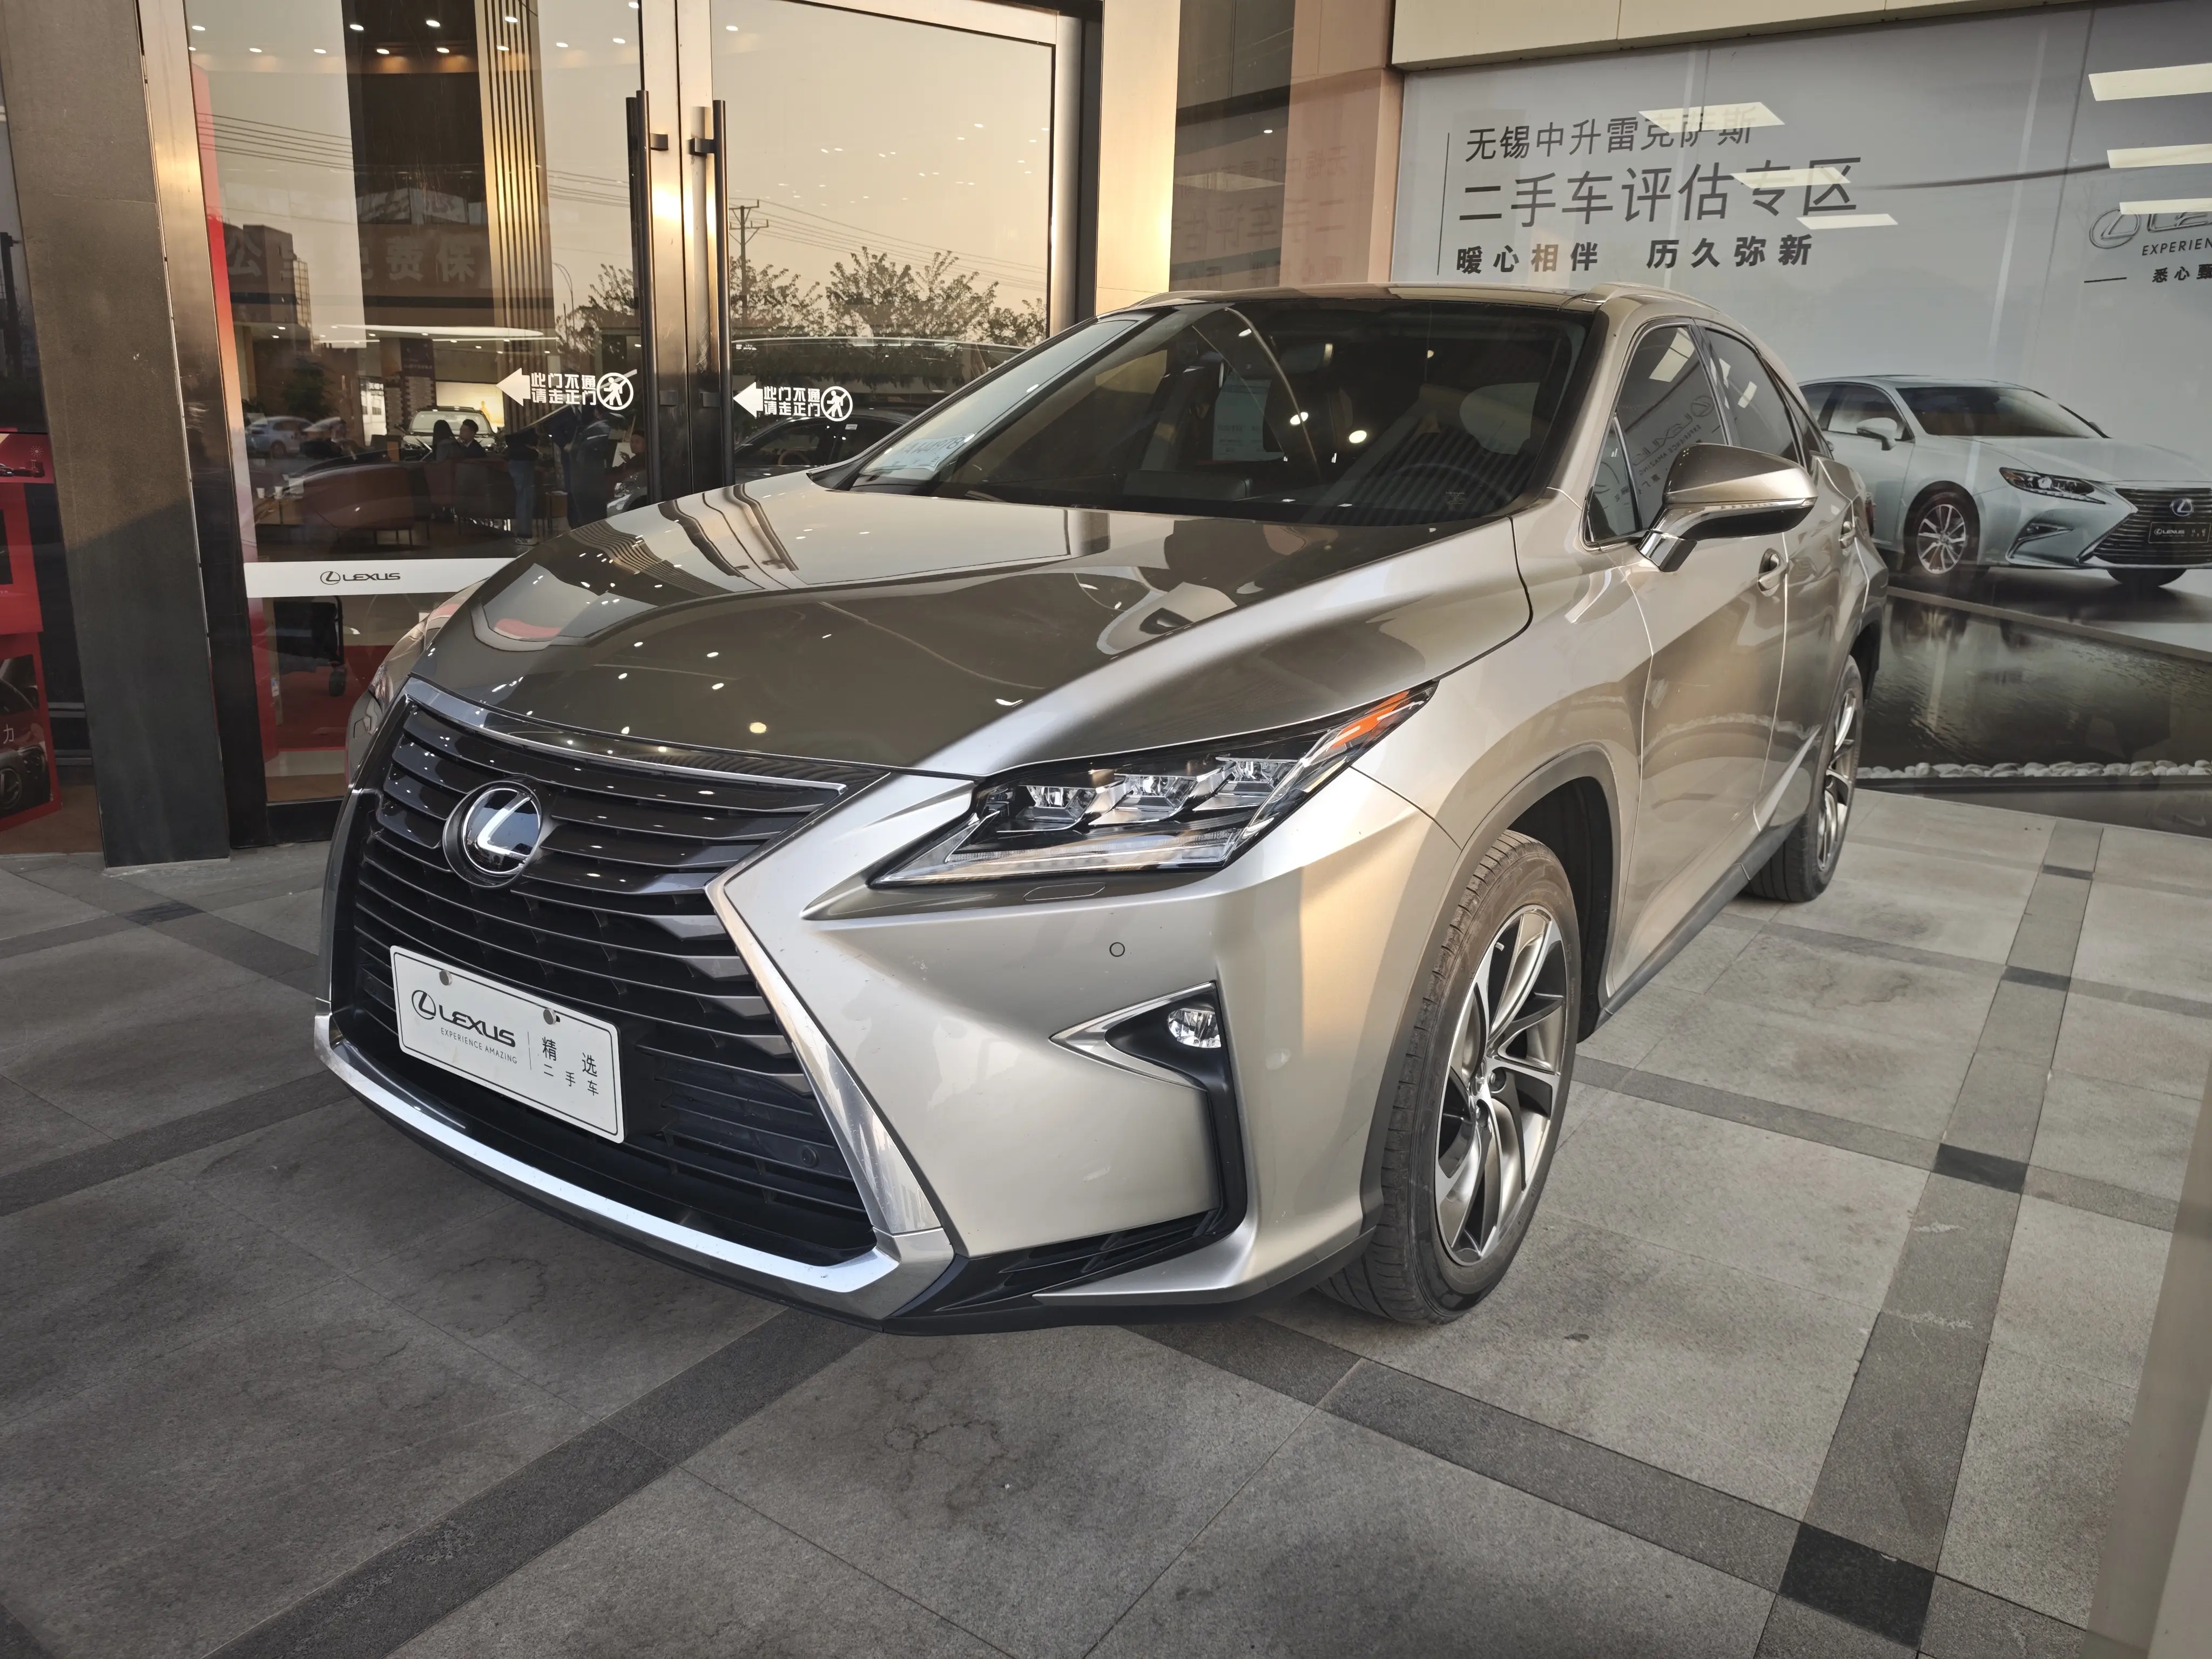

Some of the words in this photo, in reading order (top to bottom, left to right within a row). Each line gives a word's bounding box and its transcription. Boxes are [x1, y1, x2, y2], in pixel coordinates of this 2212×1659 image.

[1466, 106, 1757, 161] 无锡中升雷克萨斯
[1459, 157, 1861, 227] 二手车评估专区
[1456, 242, 1599, 274] 暖心相伴
[1647, 234, 1812, 269] 历久弥新
[531, 372, 596, 390] 此门不通
[764, 386, 820, 402] 此门不通
[531, 388, 596, 406] 请走正门
[764, 401, 820, 417] 请走正门
[343, 572, 401, 582] LEXUS
[439, 1004, 516, 1048] LEXUS
[441, 1027, 482, 1050] EXPERIENCE
[485, 1046, 517, 1064] AMAZING
